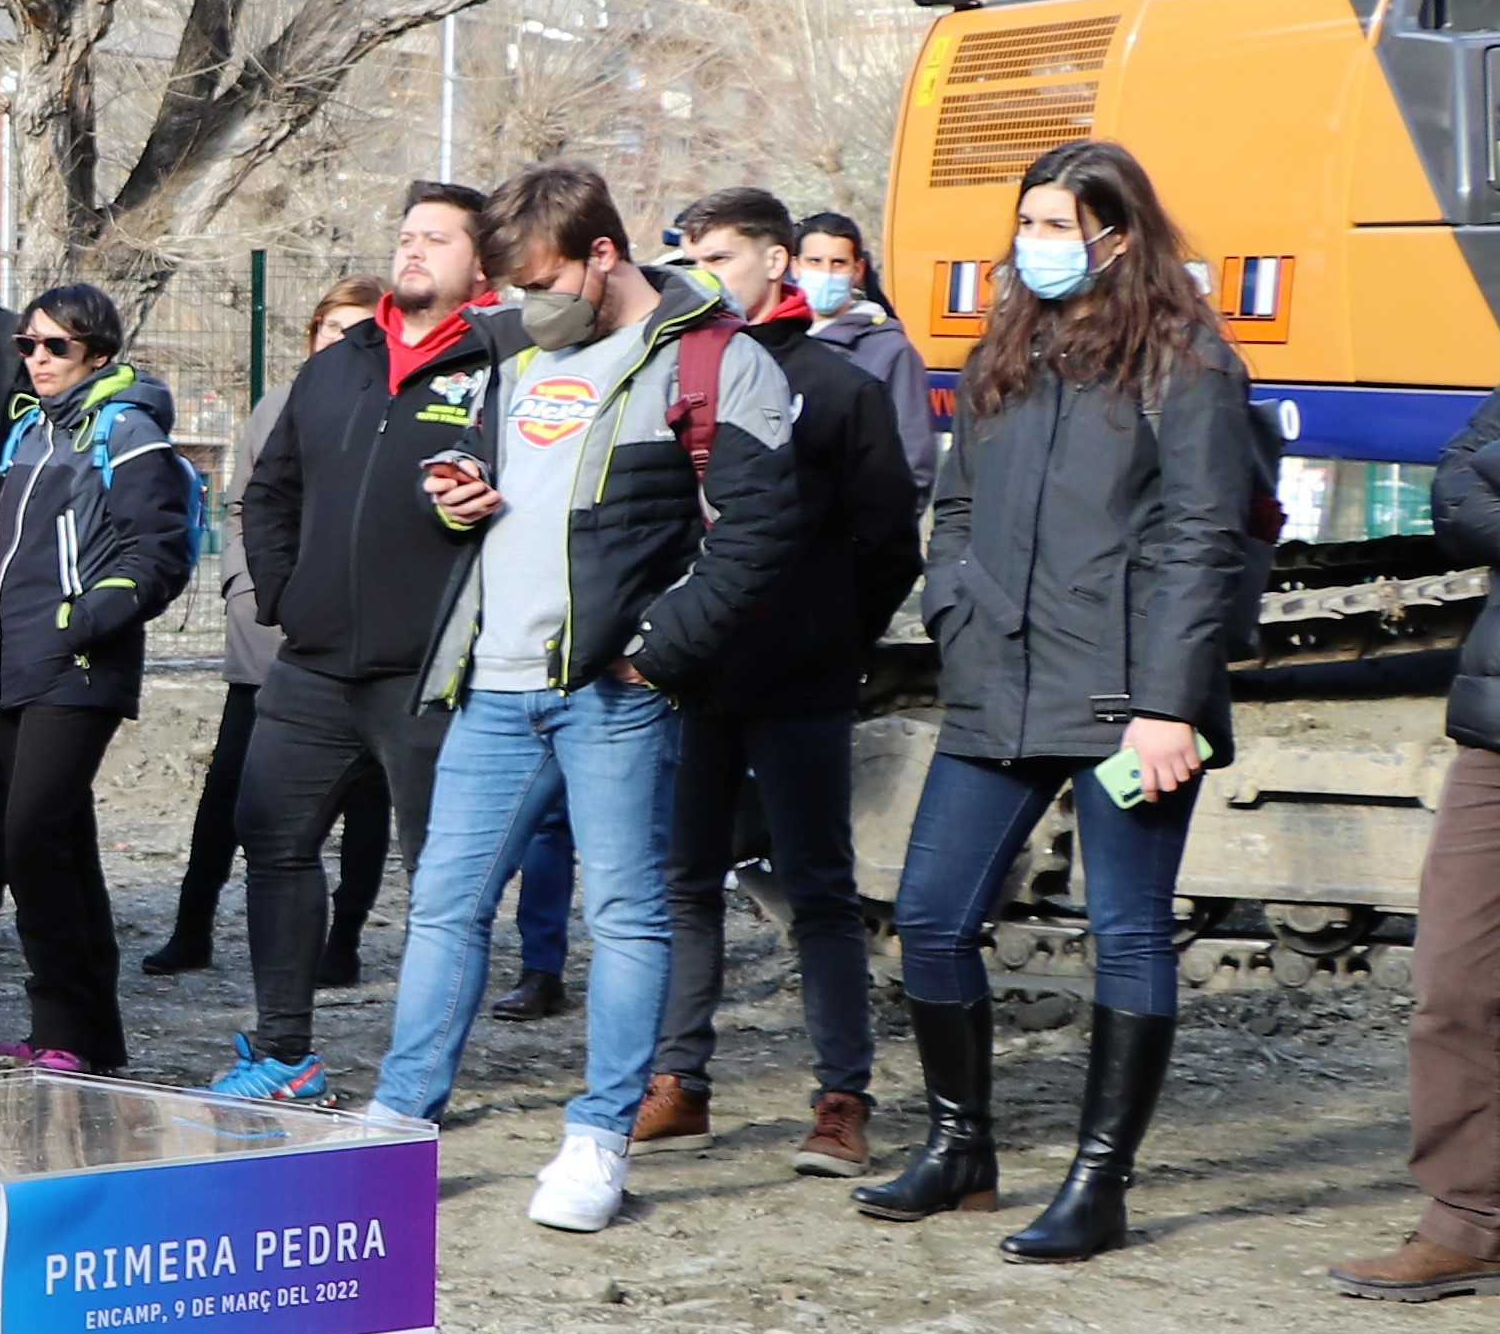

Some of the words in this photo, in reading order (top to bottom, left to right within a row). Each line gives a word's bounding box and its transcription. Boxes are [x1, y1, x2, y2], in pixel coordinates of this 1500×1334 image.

[45, 1235, 237, 1296] PRIMERA
[254, 1218, 387, 1272] PEDRA
[85, 1302, 169, 1330] ENCAMP,
[173, 1304, 186, 1320] 9
[192, 1297, 216, 1317] DE
[221, 1290, 273, 1314] MARÇ
[277, 1285, 311, 1307] DEL
[315, 1279, 360, 1302] 2022
